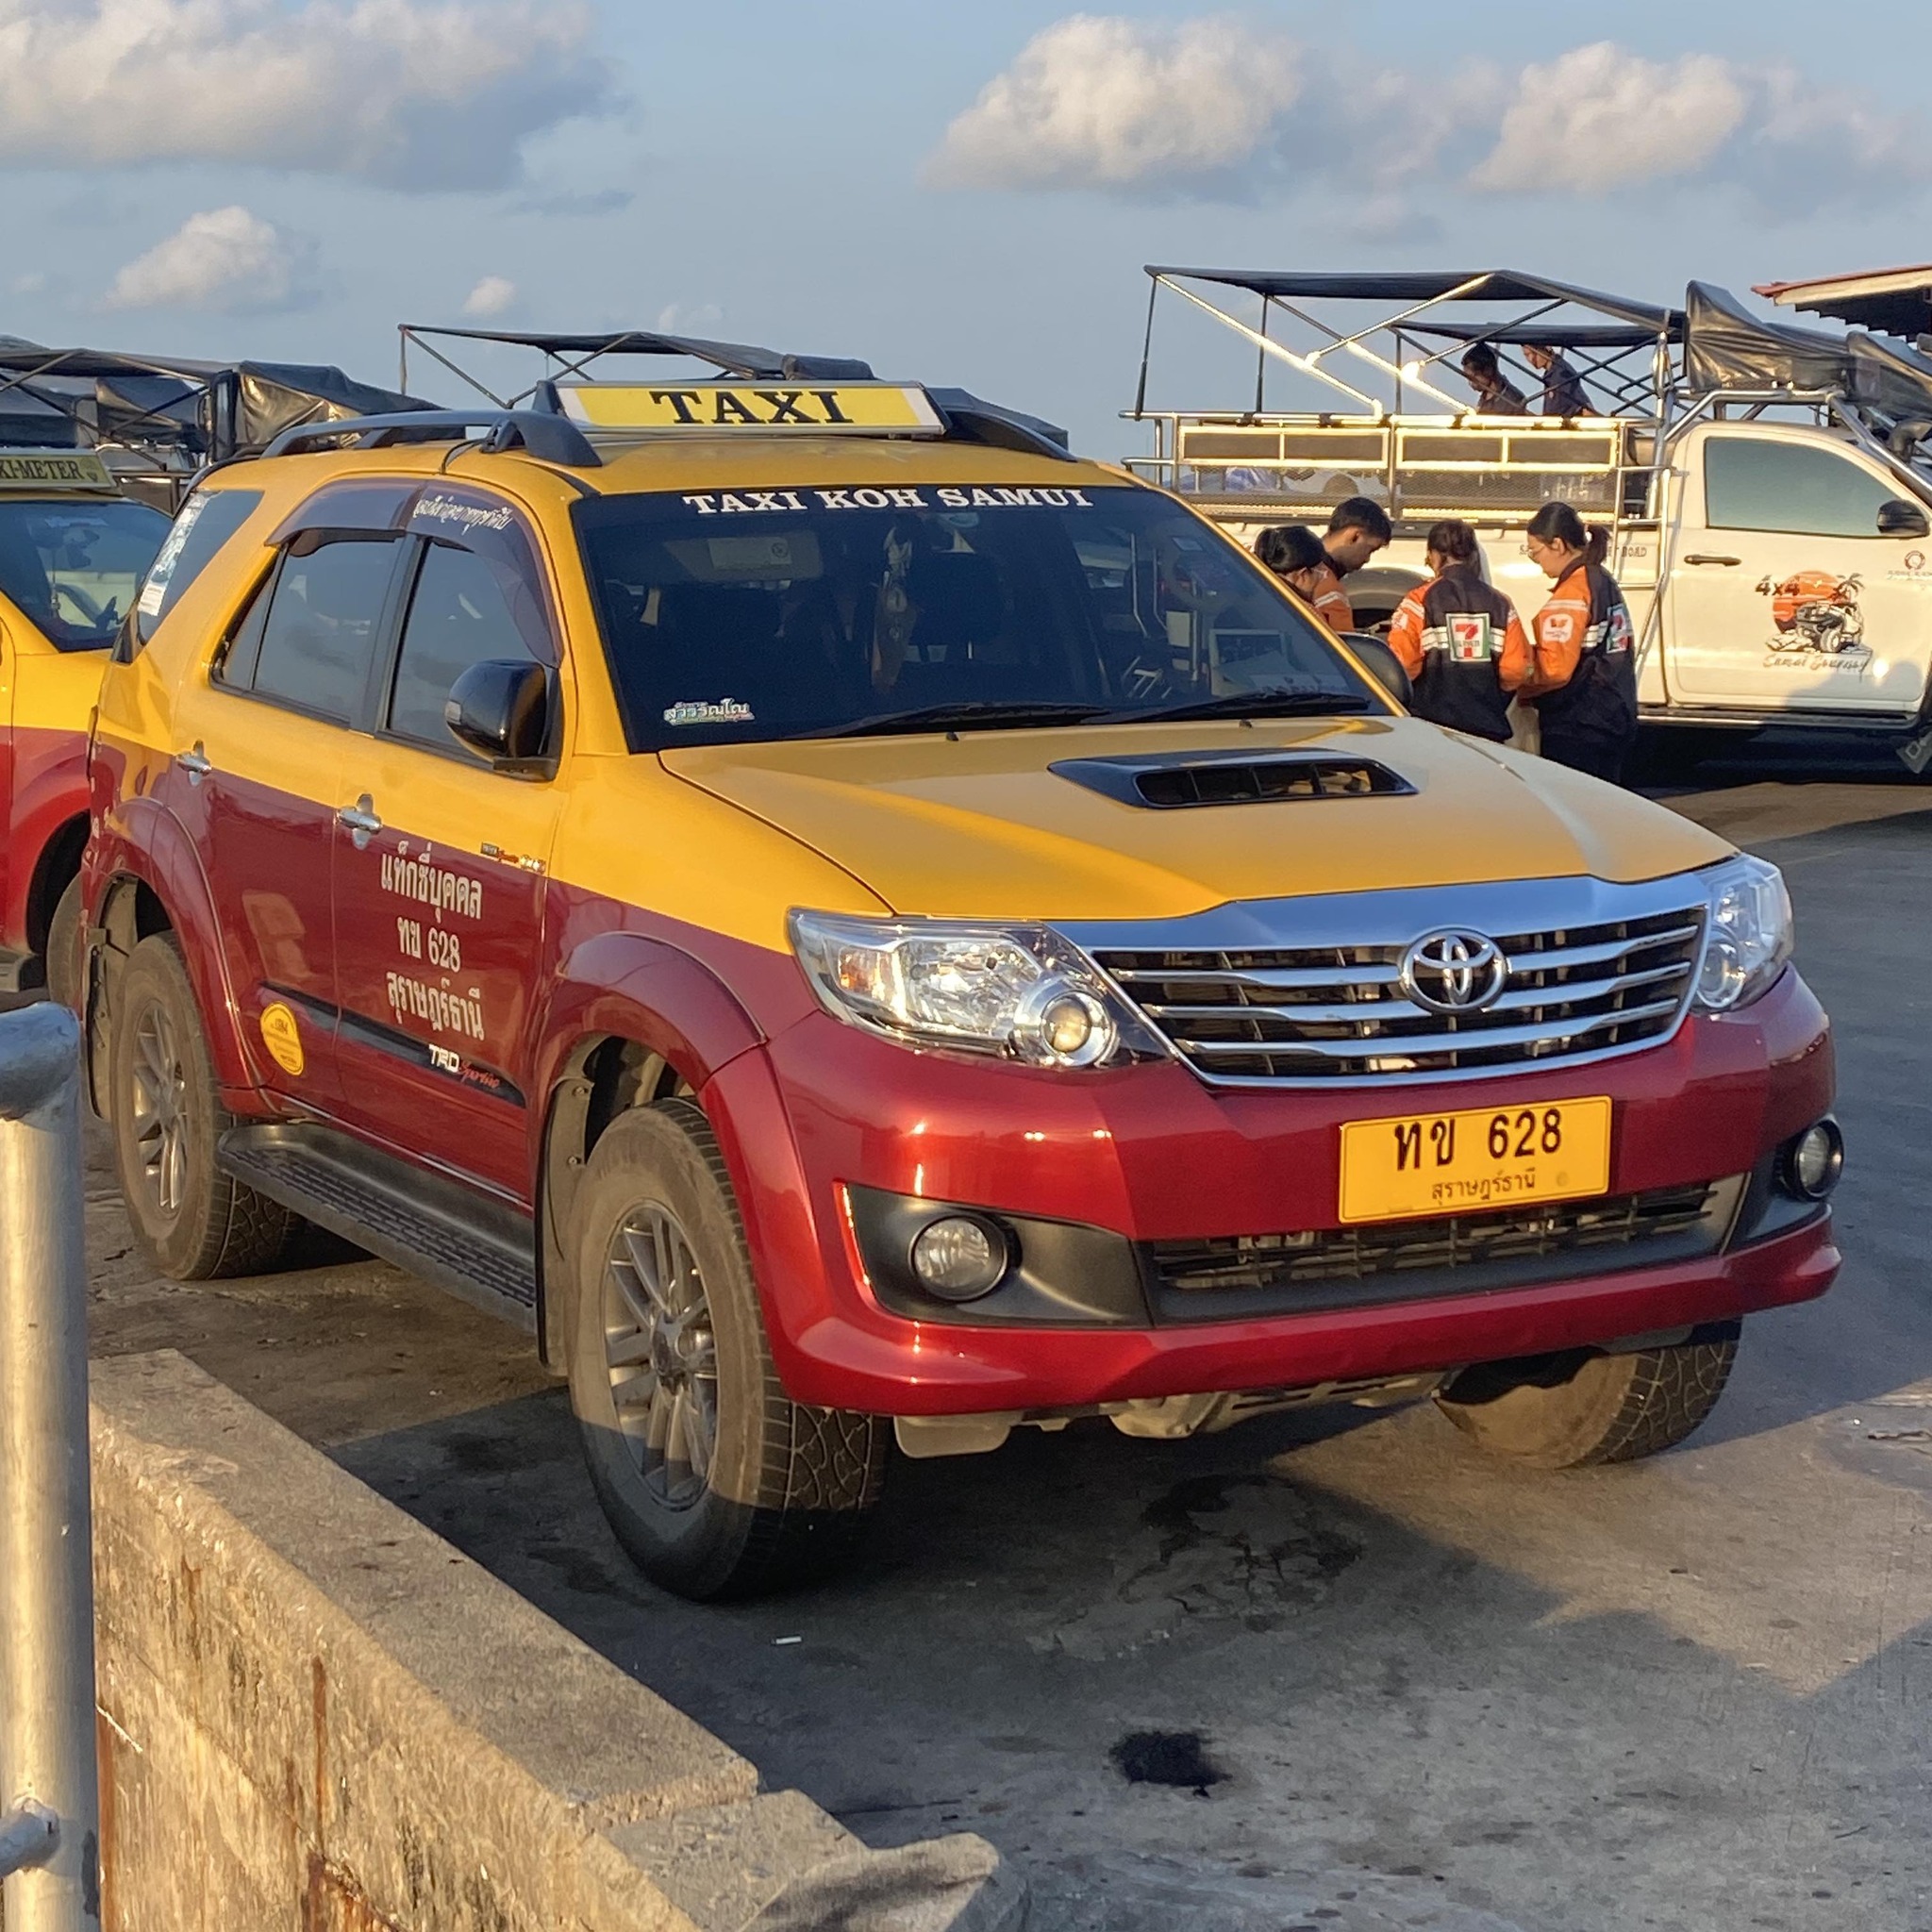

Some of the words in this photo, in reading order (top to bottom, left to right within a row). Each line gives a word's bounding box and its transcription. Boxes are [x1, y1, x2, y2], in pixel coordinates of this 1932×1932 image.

[651, 390, 854, 425] TAXI
[682, 491, 808, 514] TAXI
[813, 488, 926, 510] KOH
[936, 488, 1094, 508] SAMUI
[427, 927, 461, 973] 628
[428, 1043, 460, 1074] TRD
[1394, 1118, 1456, 1172] ทข
[1488, 1108, 1562, 1159] 628
[1431, 1167, 1537, 1206] สุราษฎร์ธานี
